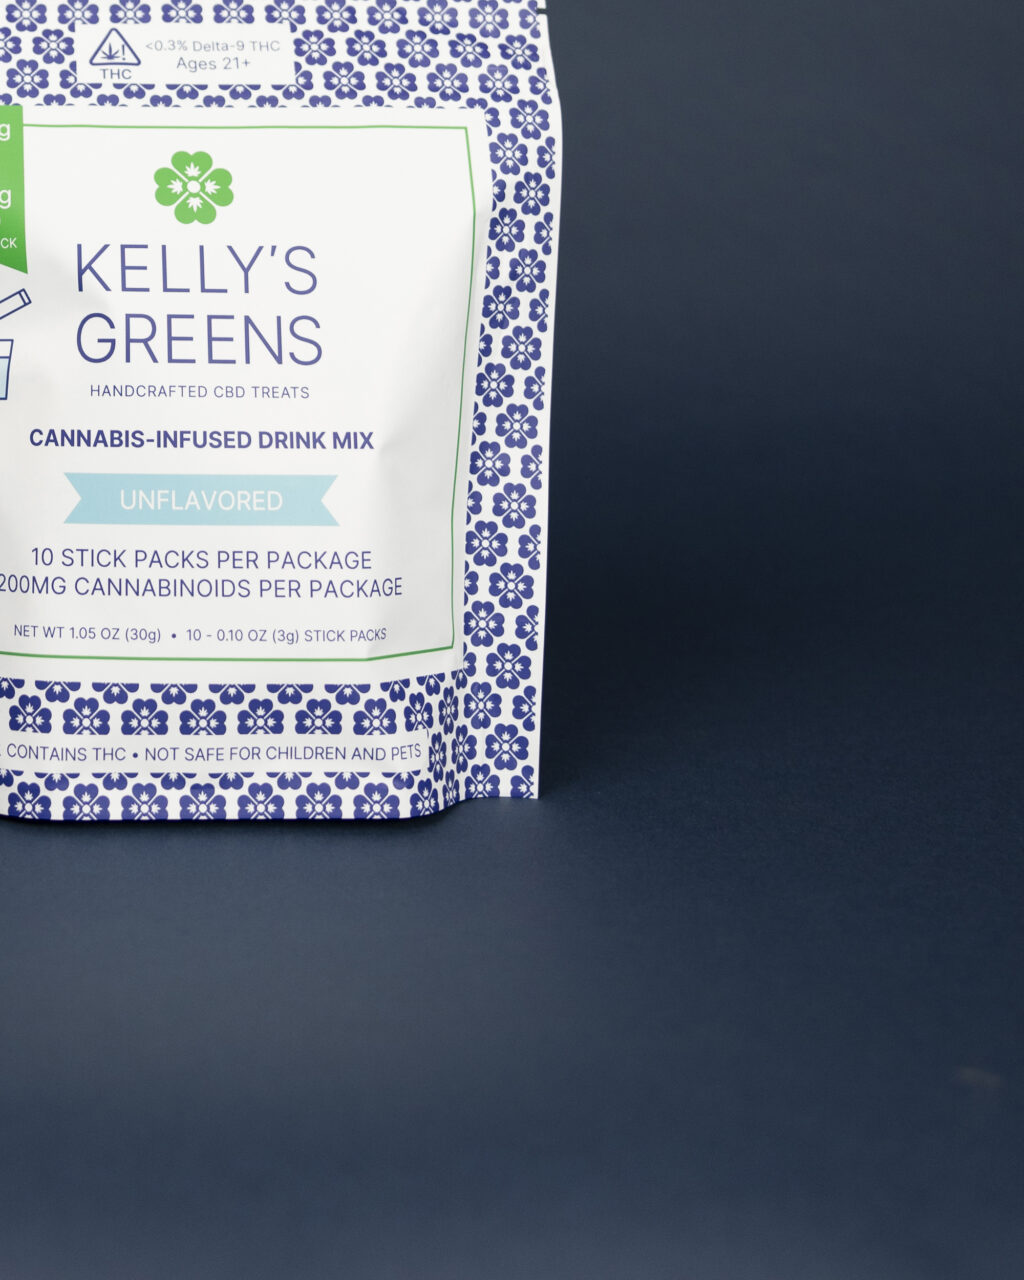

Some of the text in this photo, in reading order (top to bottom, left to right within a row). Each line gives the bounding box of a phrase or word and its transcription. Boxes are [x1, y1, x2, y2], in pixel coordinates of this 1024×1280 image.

[145, 40, 281, 52] <0.3% Delta-9 THC
[99, 68, 132, 80] THC
[177, 57, 251, 73] Ages 21+
[76, 243, 318, 296] KELLY'S
[76, 312, 323, 366] GREENS
[90, 384, 310, 399] HANDCRAFTED CBD TREATS
[29, 428, 375, 450] CANNABIS-INFUSED DRINK MIX
[120, 489, 283, 511] UNFLAVORED
[31, 547, 372, 569] 10 STICK PACKS PER PACKAGE
[74, 577, 251, 598] CANNABINOIDS
[259, 579, 301, 598] PER
[310, 577, 403, 598] PACKAGE
[14, 624, 38, 637] NET
[42, 626, 65, 639] WT
[69, 627, 96, 640] 1.05
[100, 628, 120, 640] OZ
[125, 627, 161, 644] (30g)
[186, 629, 202, 641] 10
[217, 629, 244, 642] 0.10
[248, 629, 267, 642] OZ
[272, 629, 299, 645] (3g)
[304, 629, 345, 642] STICK
[350, 627, 387, 642] PACKS
[6, 743, 87, 761] CONTAINS
[92, 747, 126, 761] THC
[145, 747, 179, 761] NOT
[184, 747, 224, 761] SAFE
[229, 746, 261, 760] FOR
[265, 746, 347, 760] CHILDREN
[351, 747, 386, 761] AND
[391, 743, 422, 761] PETS
